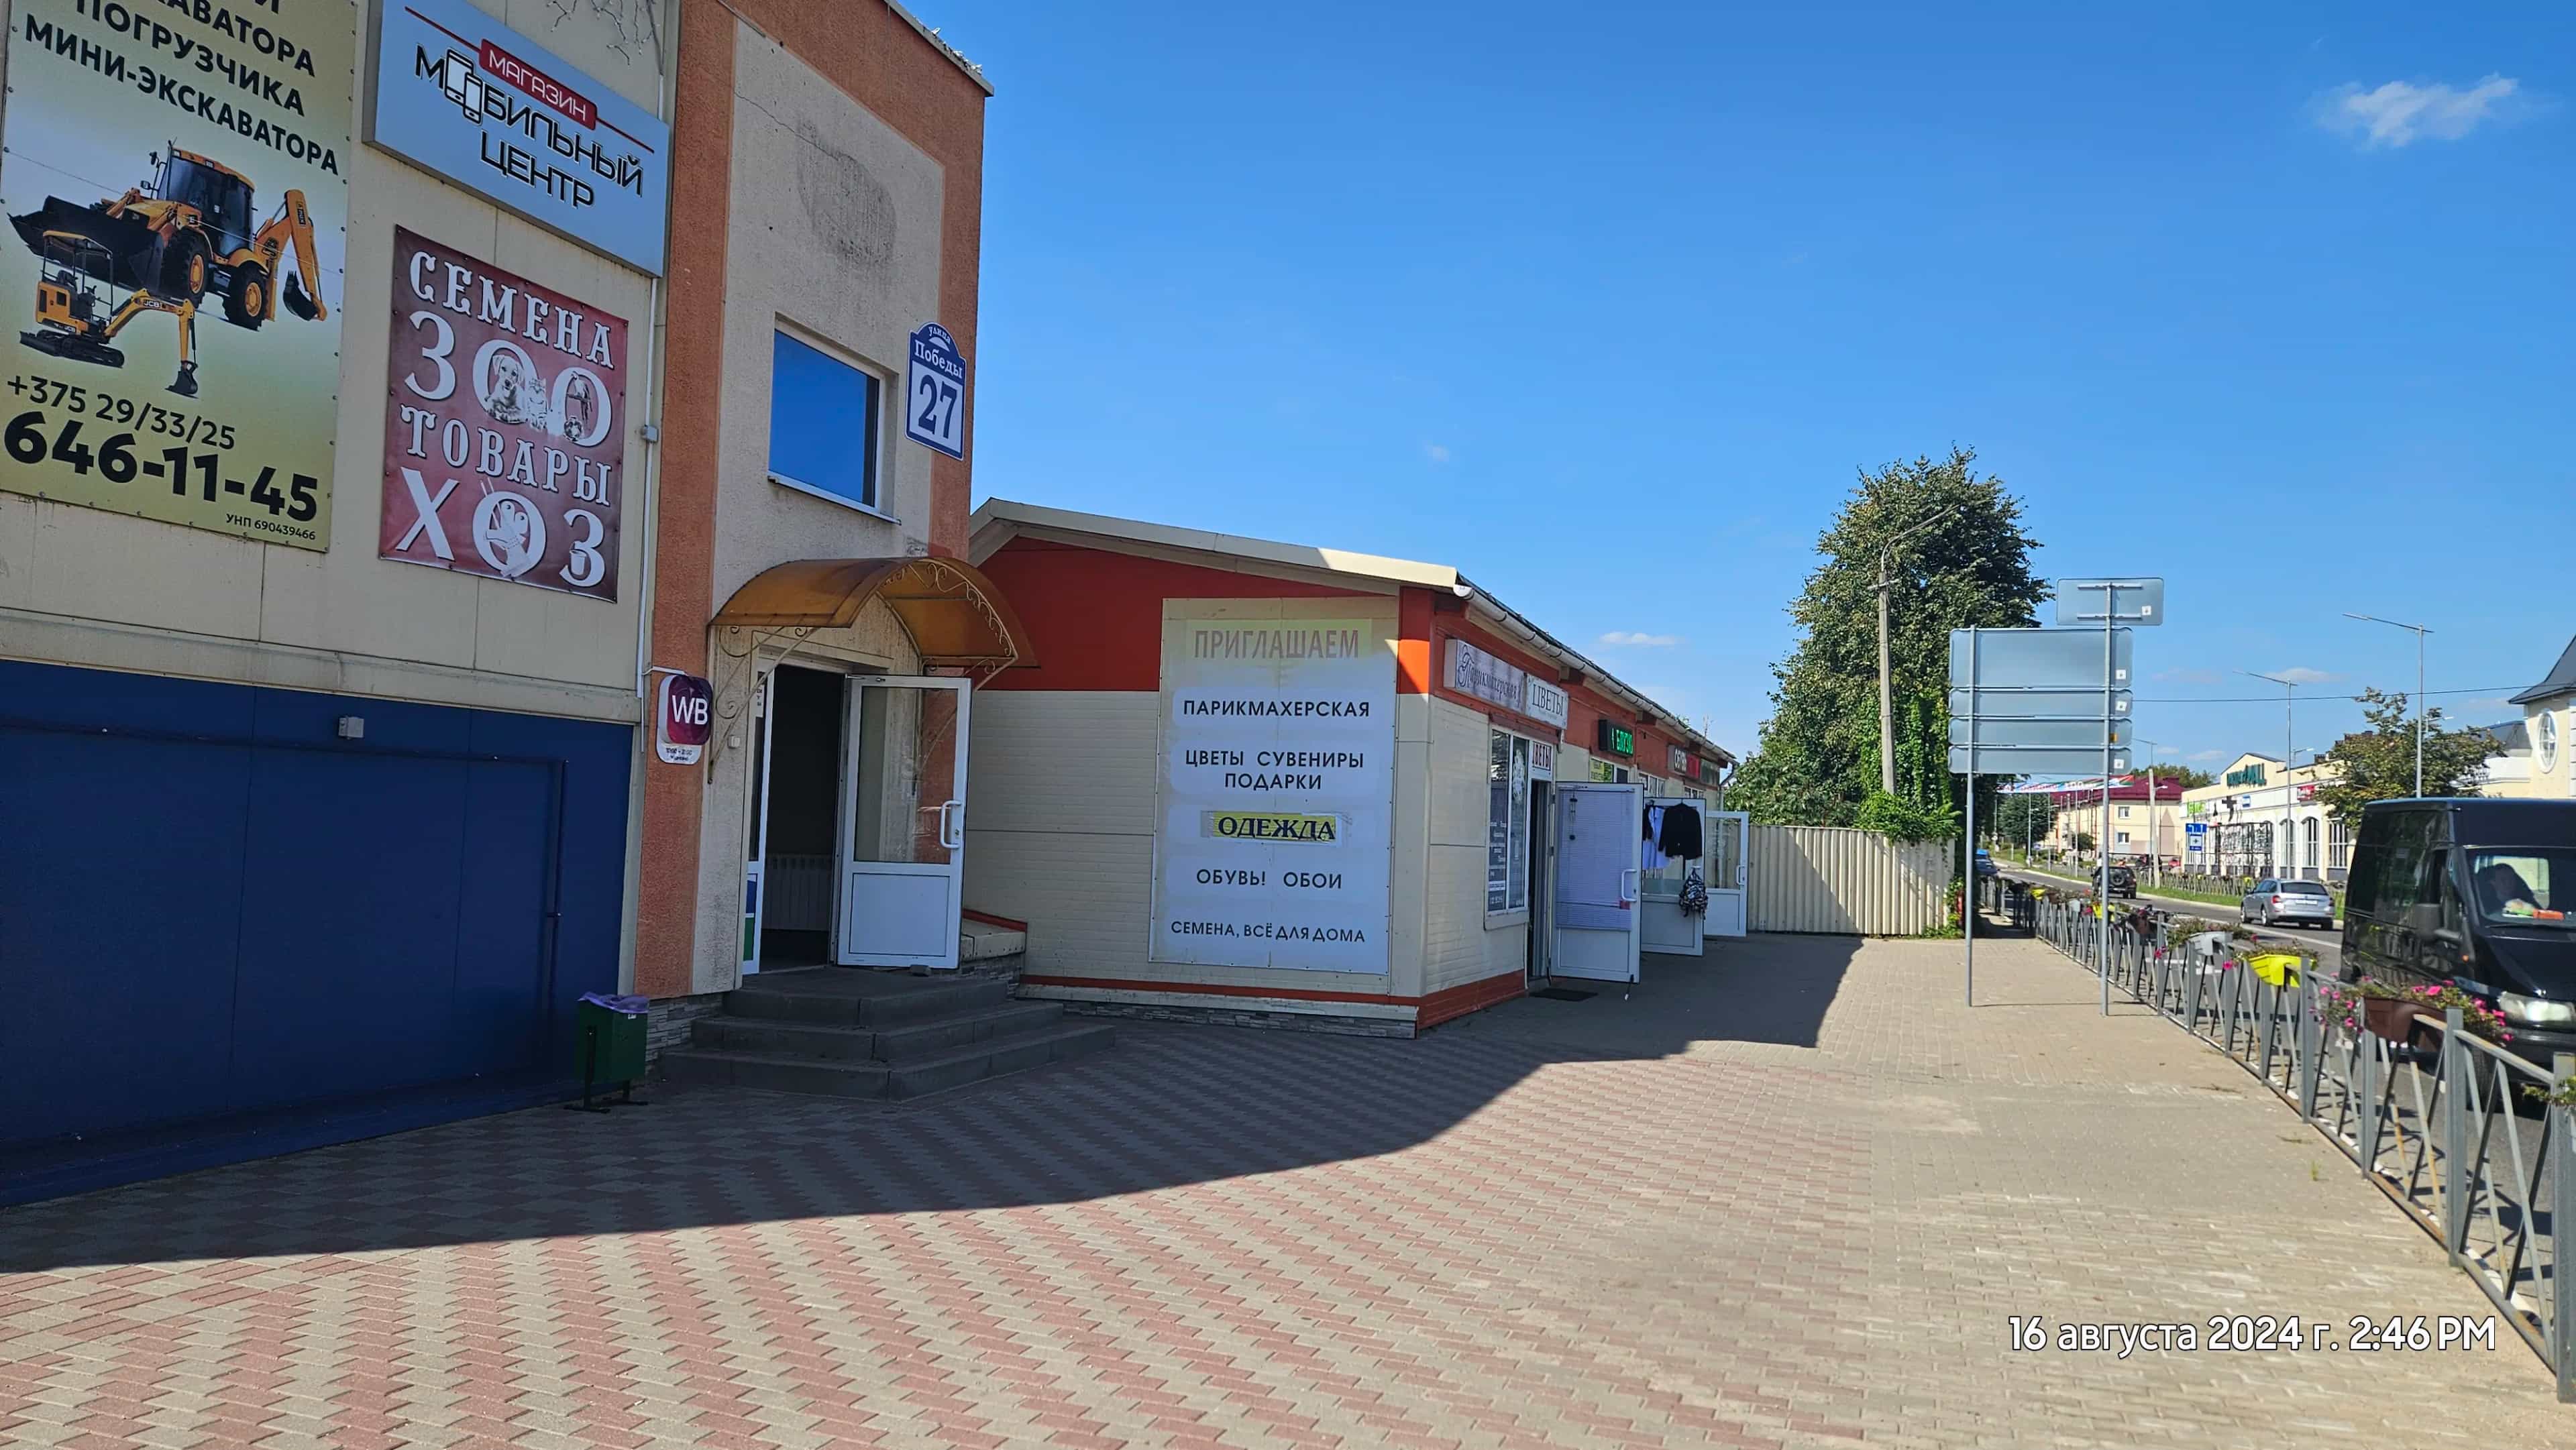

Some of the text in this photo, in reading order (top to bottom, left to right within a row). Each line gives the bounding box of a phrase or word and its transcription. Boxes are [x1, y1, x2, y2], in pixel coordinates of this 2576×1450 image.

[25, 13, 339, 175] МИНИ-ЭКСКАВАТОРА
[489, 49, 586, 121] МАГАЗИН
[480, 130, 595, 209] ЦЕНТР
[409, 251, 614, 369] СЕМЕНА
[928, 326, 951, 344] улица
[914, 339, 962, 379] Победы
[405, 311, 612, 447] ЗОО
[7, 376, 236, 449] +375 29/33/25
[918, 374, 957, 439] 27
[4, 411, 318, 522] 646-11-45
[400, 404, 612, 506] ТОВАРЫ
[226, 514, 316, 540] УНП 690439466
[395, 466, 606, 588] ХОЗ
[1194, 630, 1358, 659] ПРИГЛАШАЕМ
[672, 695, 708, 725] WB
[1183, 700, 1370, 717] ПАРИКМАХЕРСКАЯ
[1532, 683, 1564, 716] ЦВЕТЫ
[1185, 750, 1363, 768] ЦВЕТЫ СУВЕНИРЫ
[1225, 773, 1321, 791] ПОДАРКИ
[1218, 817, 1336, 840] ОДЕЖДА
[1196, 869, 1342, 889] ОБУВЬ! ОБОИ
[1171, 922, 1365, 942] СЕМЕНА, ВСЁ ДЛЯ ДОМА
